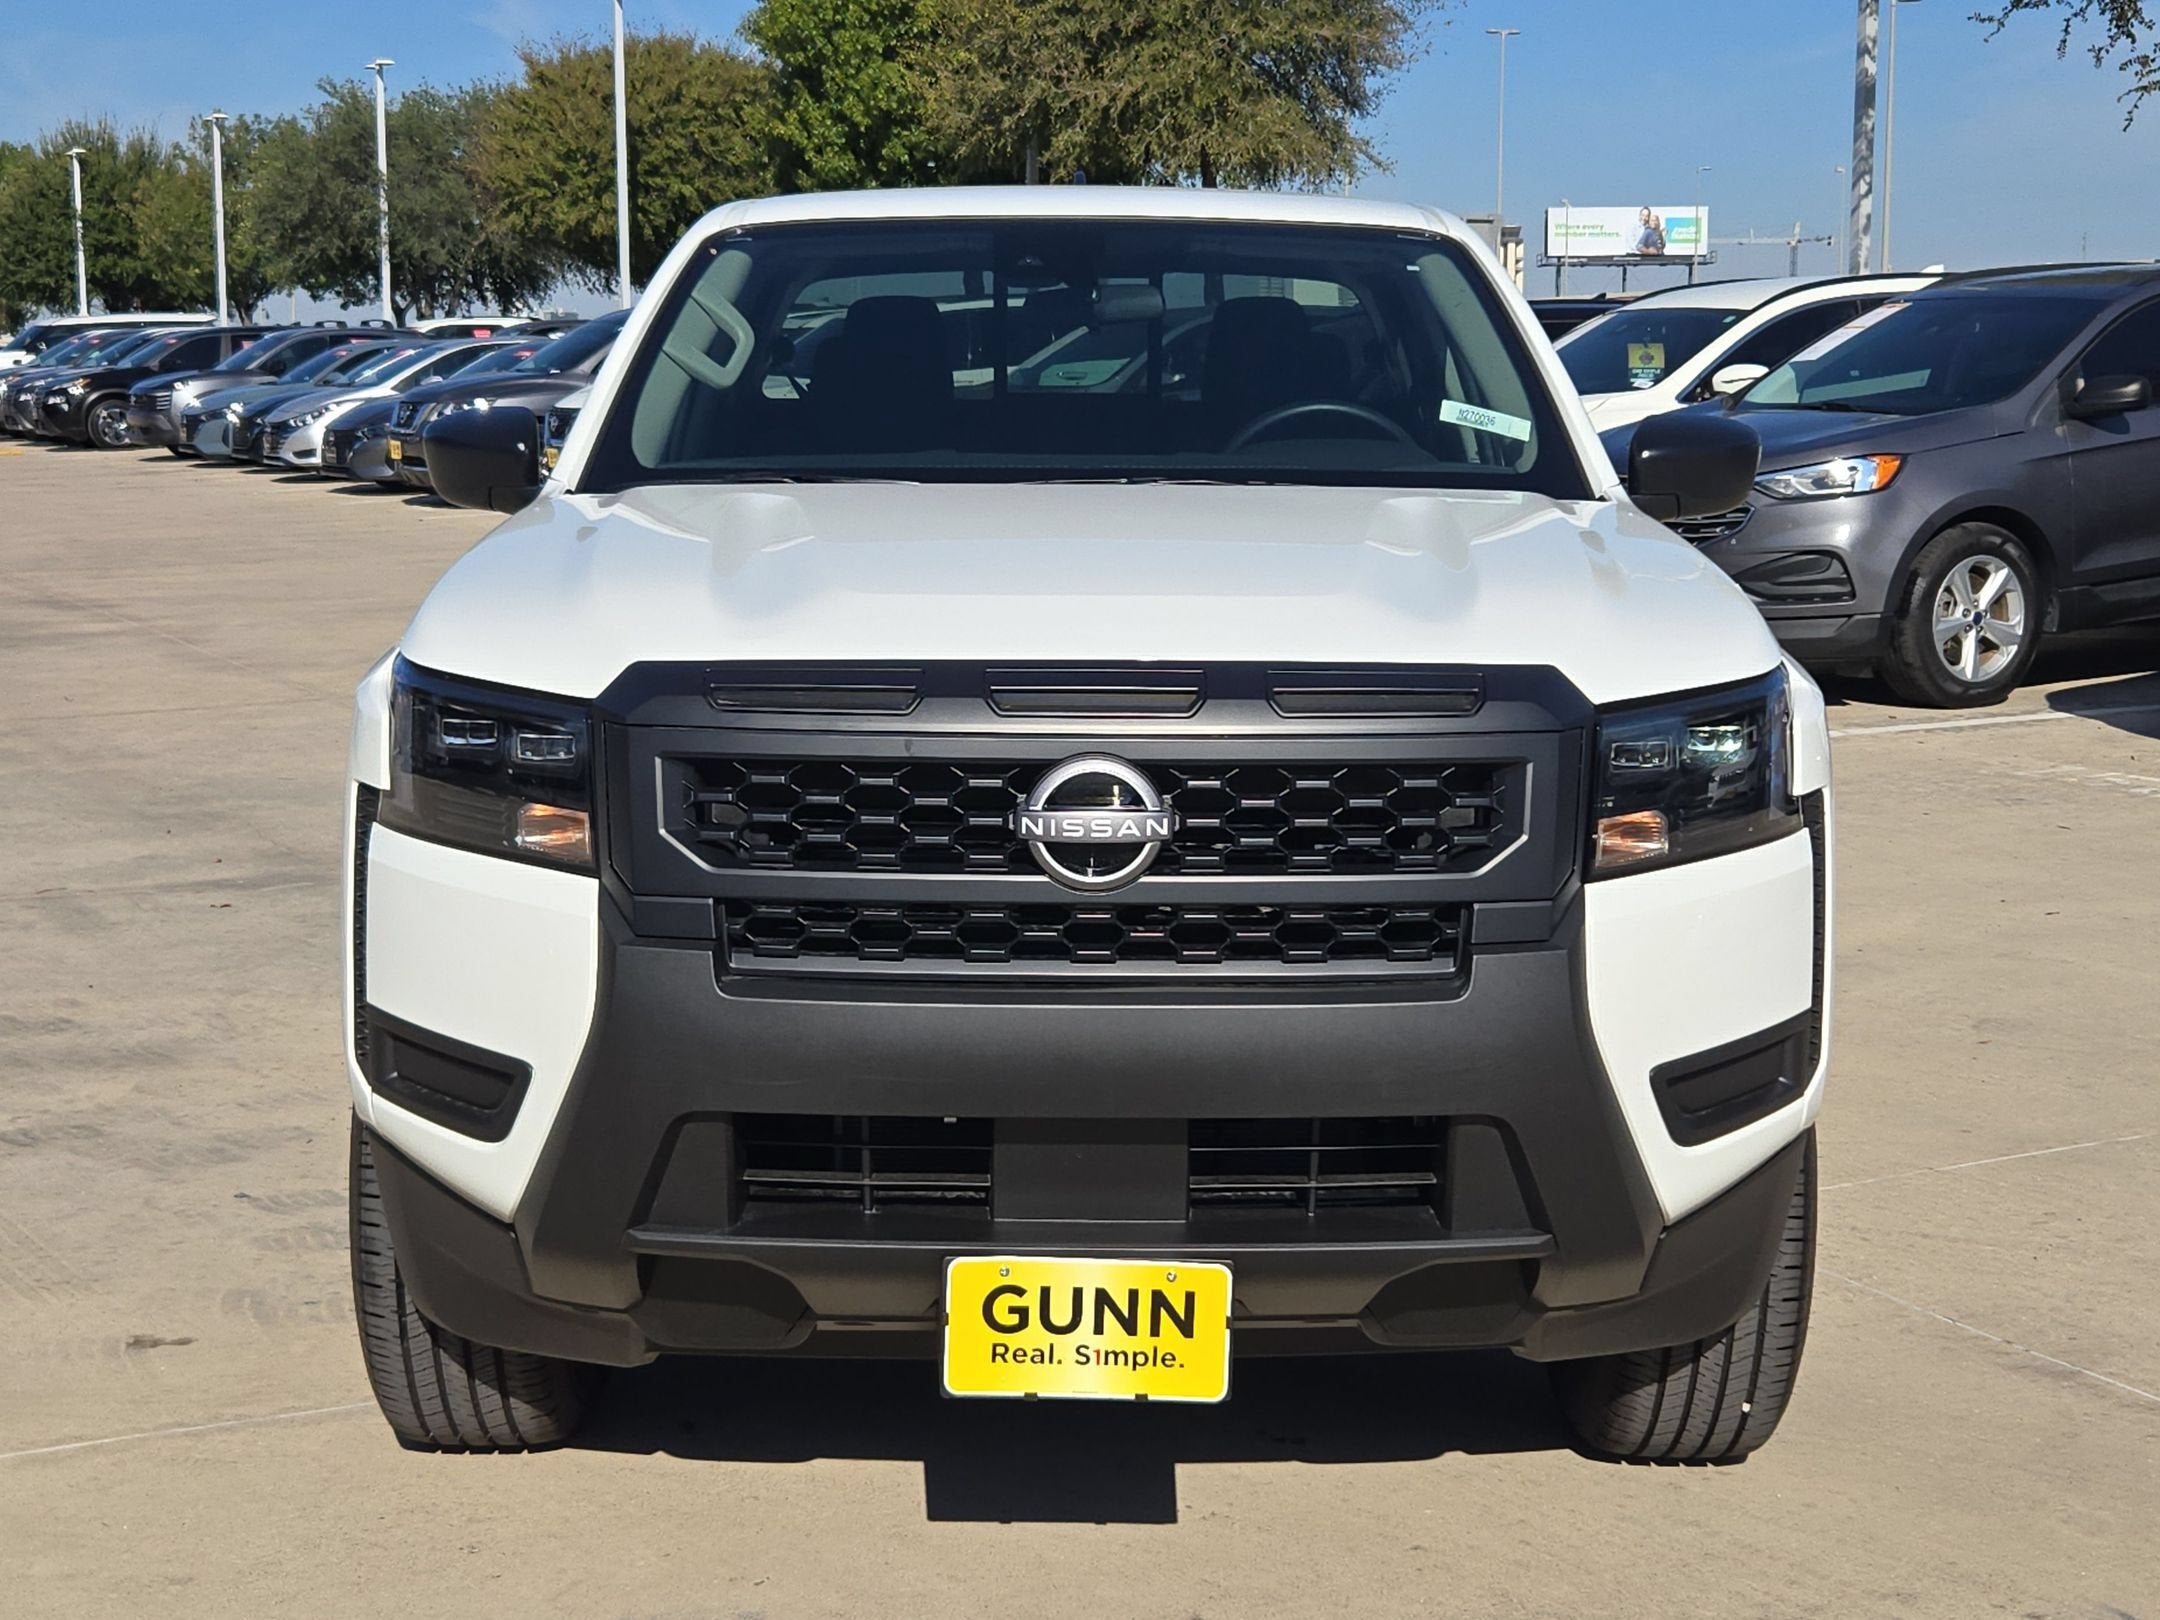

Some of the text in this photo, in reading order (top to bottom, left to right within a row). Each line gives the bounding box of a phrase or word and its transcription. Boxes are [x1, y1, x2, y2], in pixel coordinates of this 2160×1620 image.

[1020, 816, 1169, 838] NISSAN
[981, 1284, 1196, 1339] GUNN
[991, 1342, 1063, 1365] Real.
